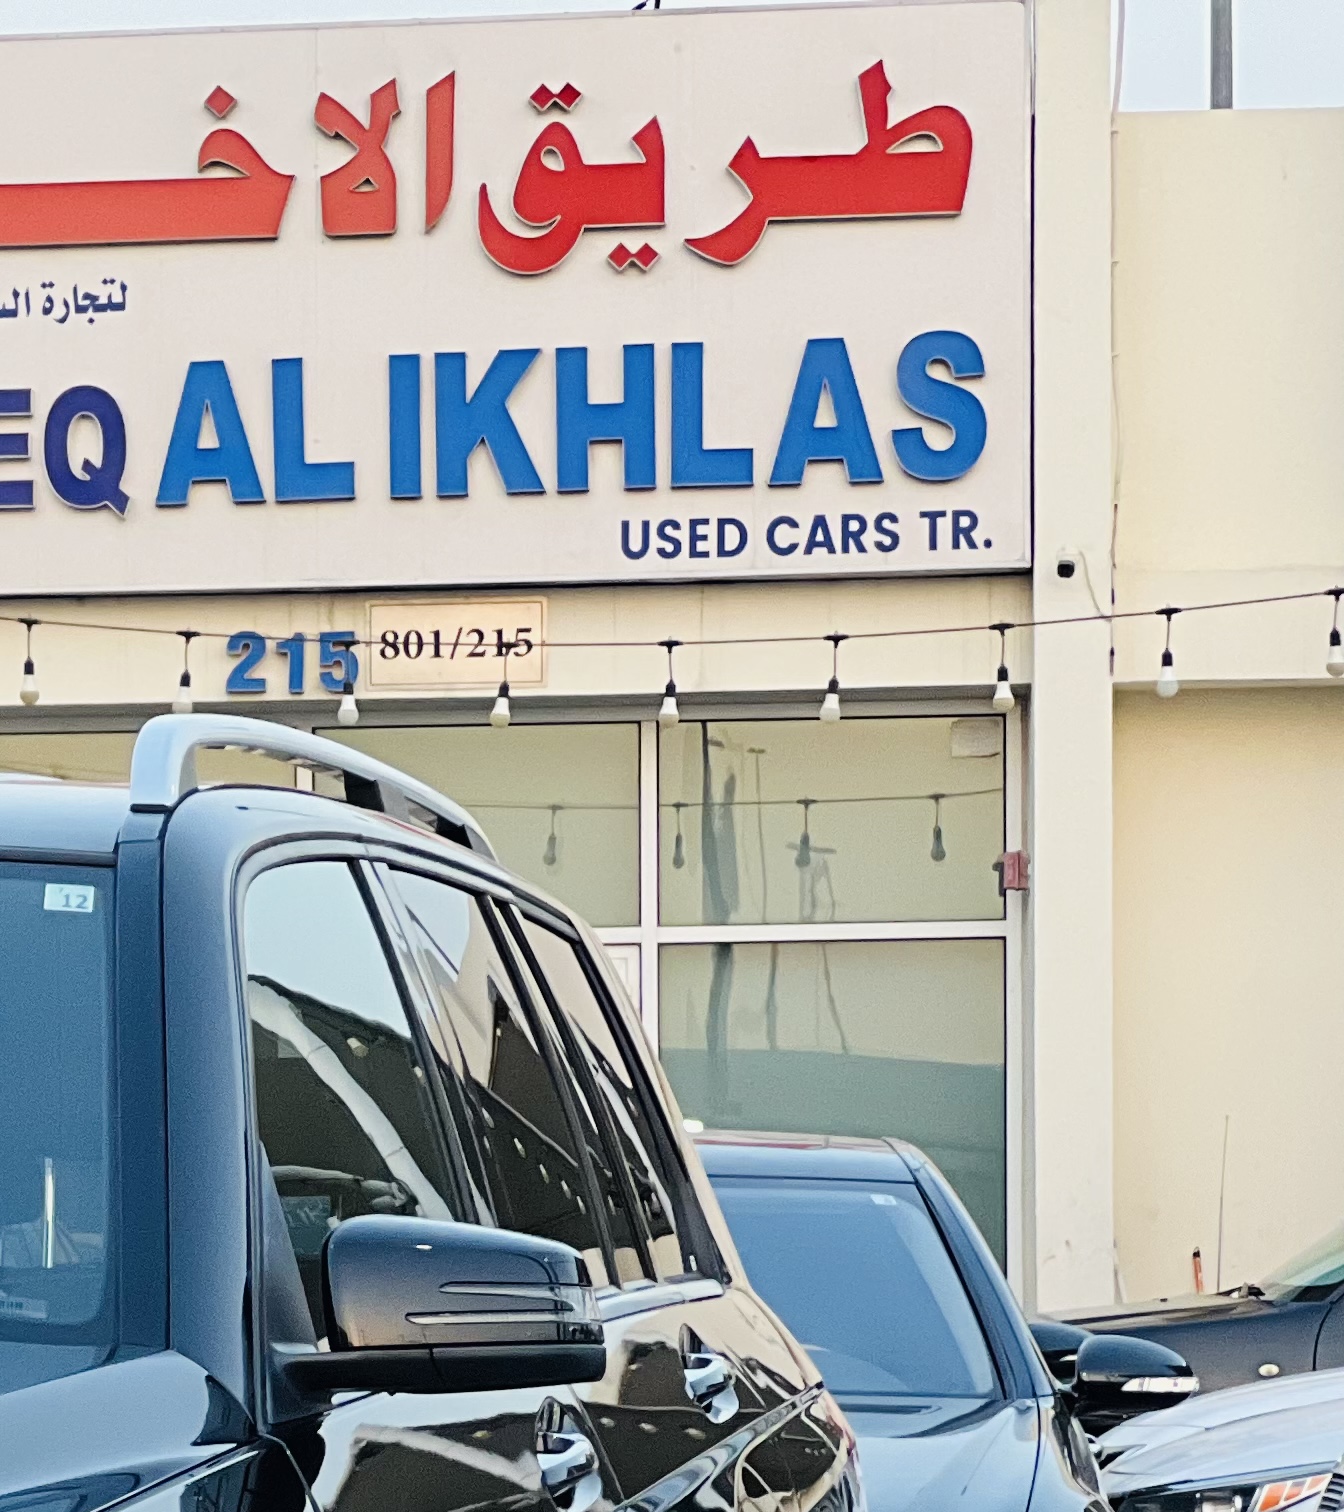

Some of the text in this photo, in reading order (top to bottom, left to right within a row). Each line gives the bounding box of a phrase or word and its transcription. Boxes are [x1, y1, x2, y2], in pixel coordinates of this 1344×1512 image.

[478, 60, 974, 275] طريق
[41, 277, 128, 326] لتجارة
[156, 357, 356, 508] AL
[388, 330, 988, 500] IKHLAS
[621, 509, 993, 560] USED CARS TR.
[225, 630, 359, 694] 215
[379, 626, 533, 661] 801/215
